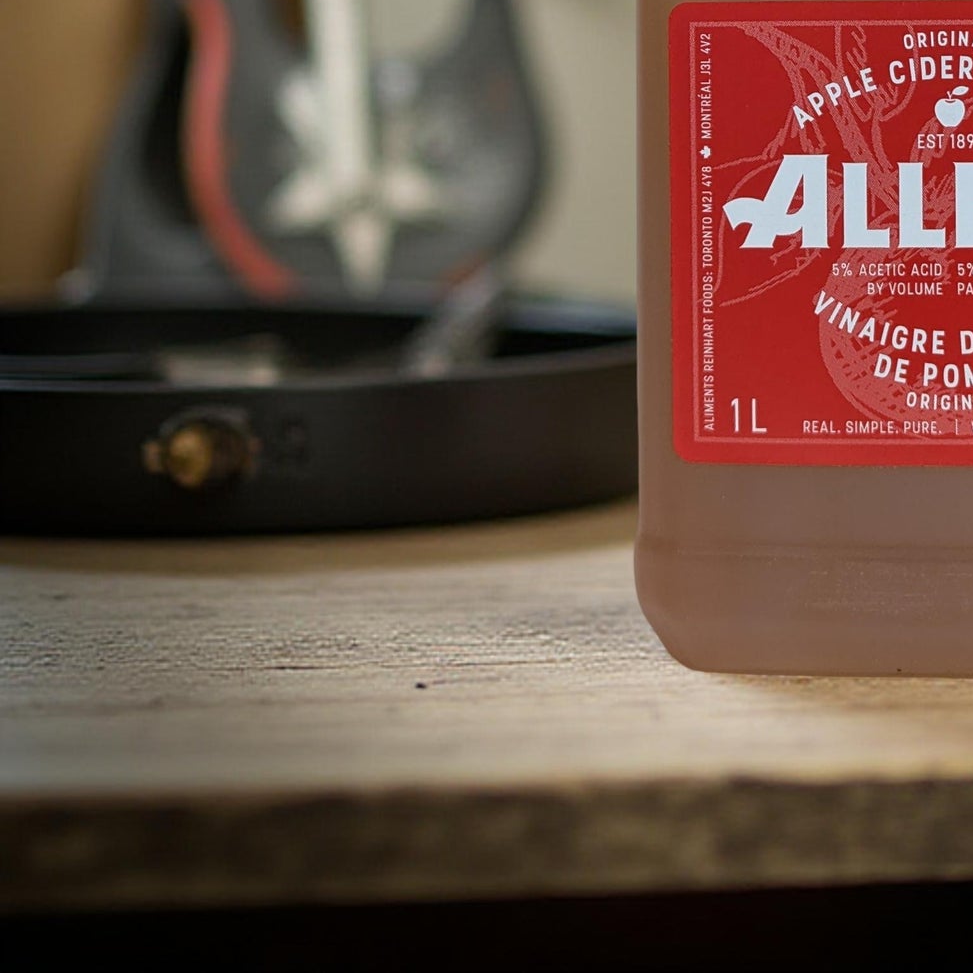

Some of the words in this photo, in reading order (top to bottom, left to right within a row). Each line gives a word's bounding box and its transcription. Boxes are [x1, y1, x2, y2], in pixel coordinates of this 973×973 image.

[700, 32, 712, 55] 4V2
[700, 57, 712, 76] J3L
[792, 67, 878, 130] APPLE
[889, 55, 973, 85] CIDER
[697, 78, 712, 139] MONTRÉAL
[917, 133, 945, 149] EST
[701, 165, 712, 188] 4Y8
[701, 190, 713, 214] M2J
[702, 216, 713, 268] TORONTO
[832, 262, 853, 277] 5%
[859, 263, 906, 276] ACETIC
[911, 263, 943, 276] ACID
[703, 270, 714, 314] FOODS:
[867, 282, 884, 295] BY
[889, 282, 943, 295] VOLUME
[814, 290, 945, 355] VINAIGRE
[703, 318, 714, 372] REINHART
[873, 353, 910, 384] DE
[704, 374, 715, 431] ALIMENTS
[803, 420, 841, 434] REAL.
[845, 420, 899, 434] SIMPLE.
[903, 421, 942, 434] PURE.
